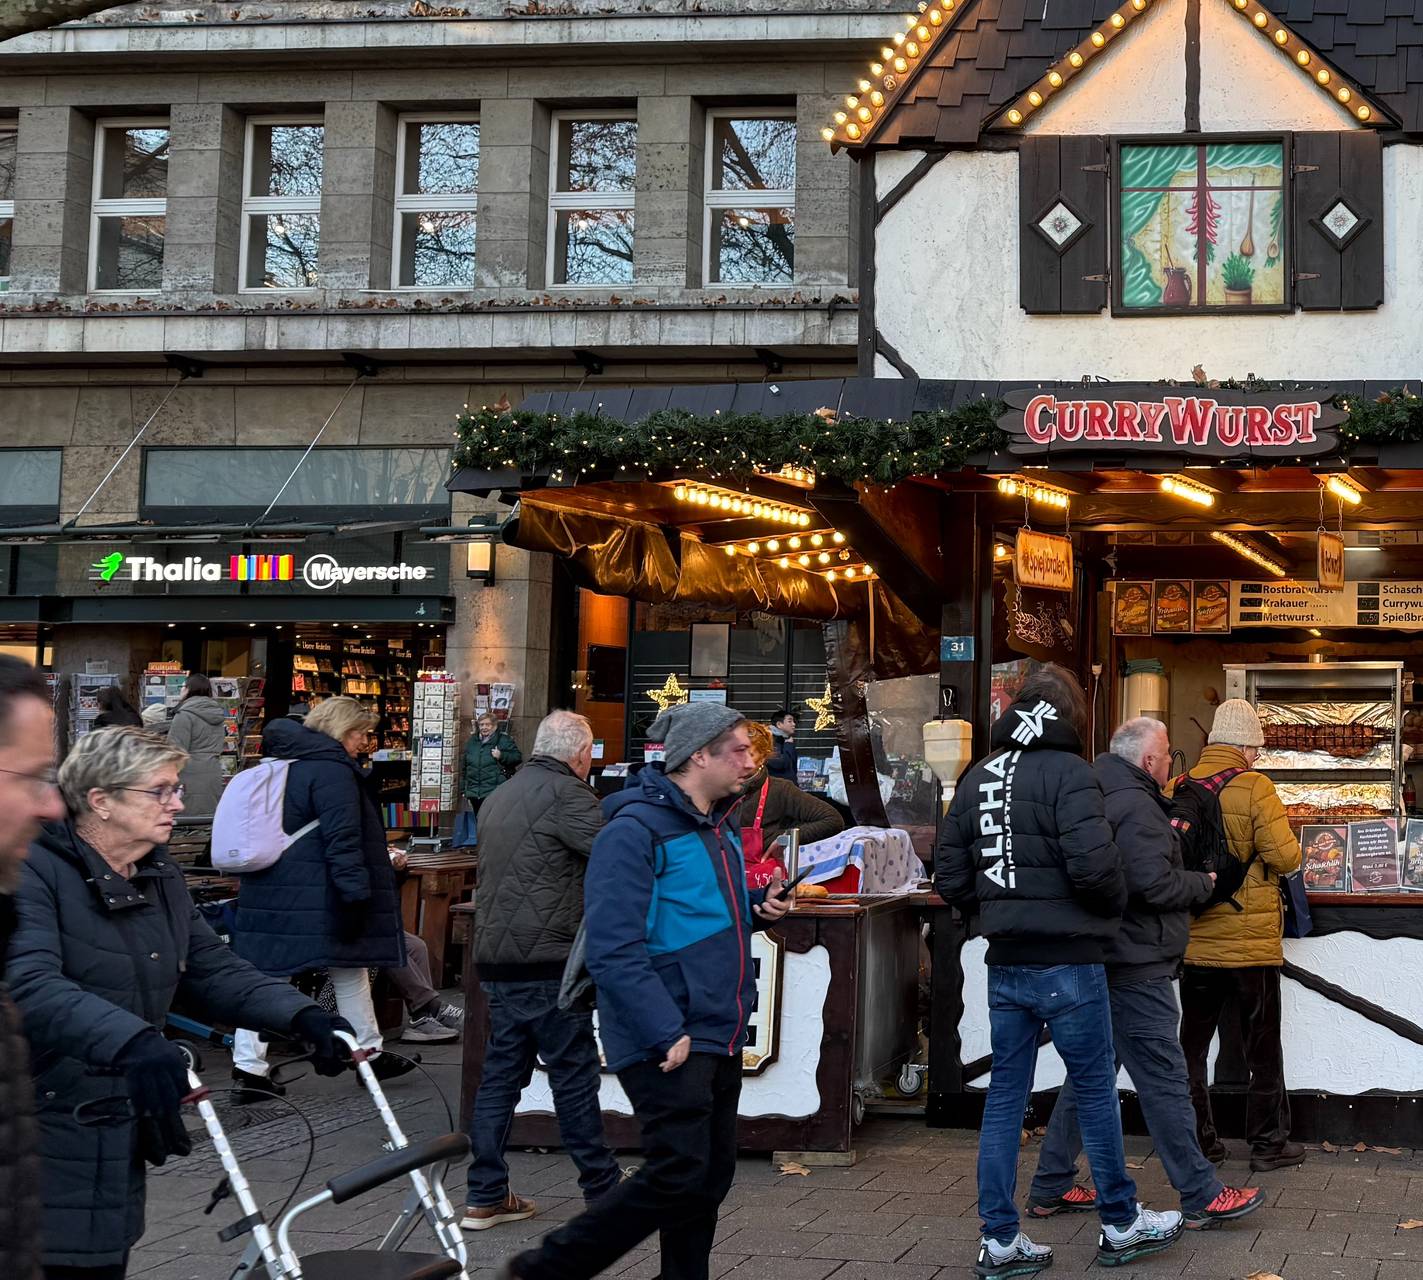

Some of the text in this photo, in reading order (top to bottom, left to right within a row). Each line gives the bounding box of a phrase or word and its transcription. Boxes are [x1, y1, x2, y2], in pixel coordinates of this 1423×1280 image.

[125, 556, 427, 584] Thalia Mayersche
[1263, 585, 1333, 595] Rostbratwurst
[1263, 599, 1308, 608] Krakauer
[1263, 613, 1314, 622] Mettwurst
[951, 642, 964, 651] 31
[979, 751, 1012, 888] ALPHA
[1004, 766, 1016, 869] INDUSTRIES
